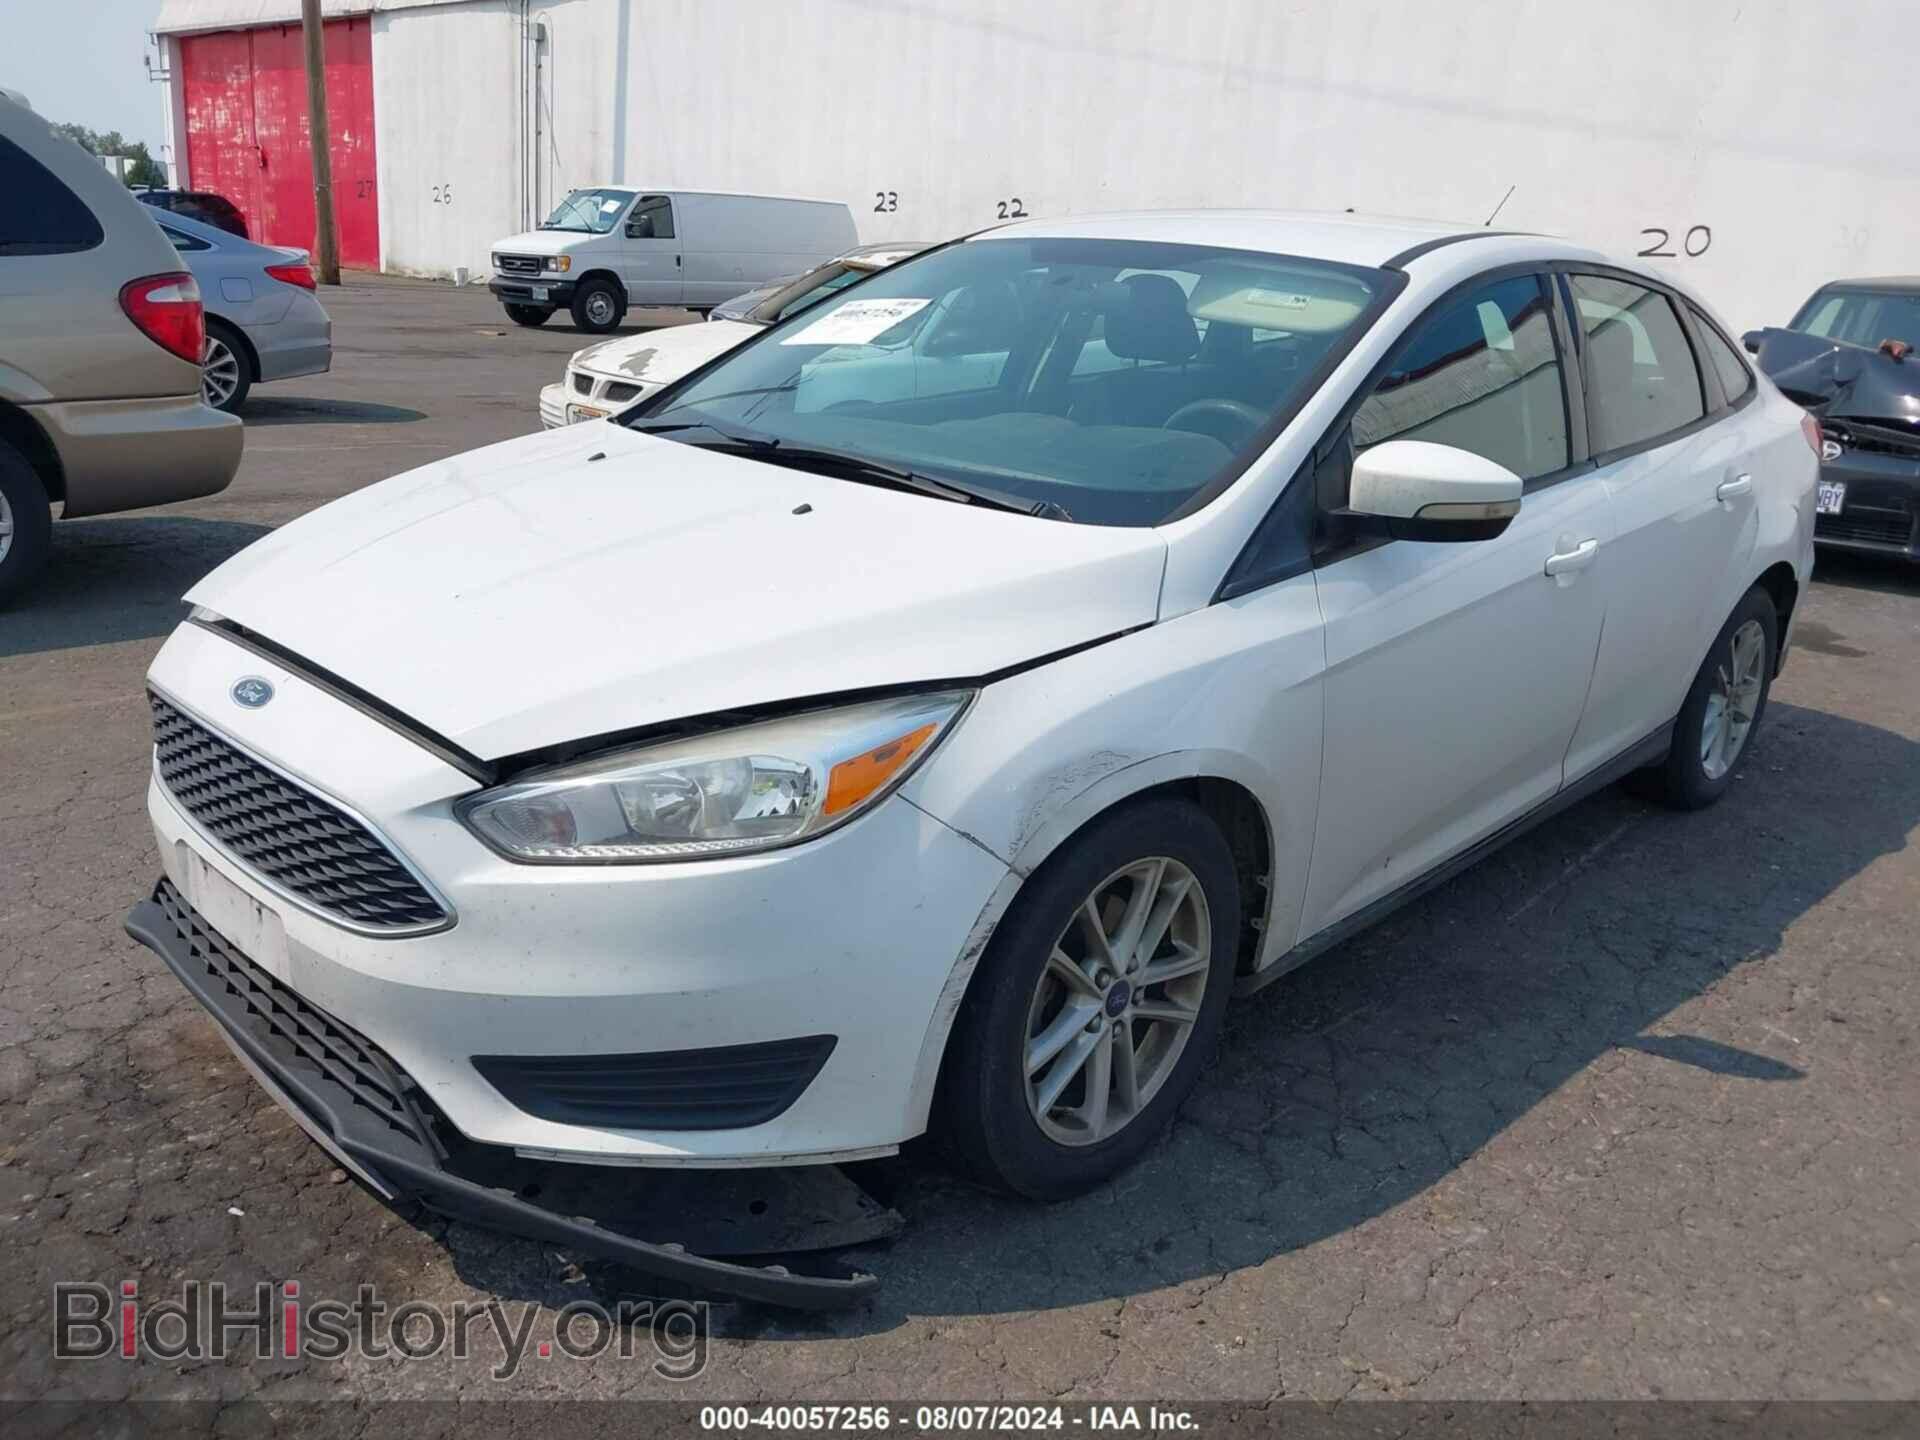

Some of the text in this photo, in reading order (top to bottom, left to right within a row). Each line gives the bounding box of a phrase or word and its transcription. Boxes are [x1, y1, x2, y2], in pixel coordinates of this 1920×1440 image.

[357, 178, 373, 198] 27
[432, 184, 452, 205] 26
[874, 191, 898, 213] 23
[997, 198, 1029, 220] 22
[1638, 225, 1711, 257] 20
